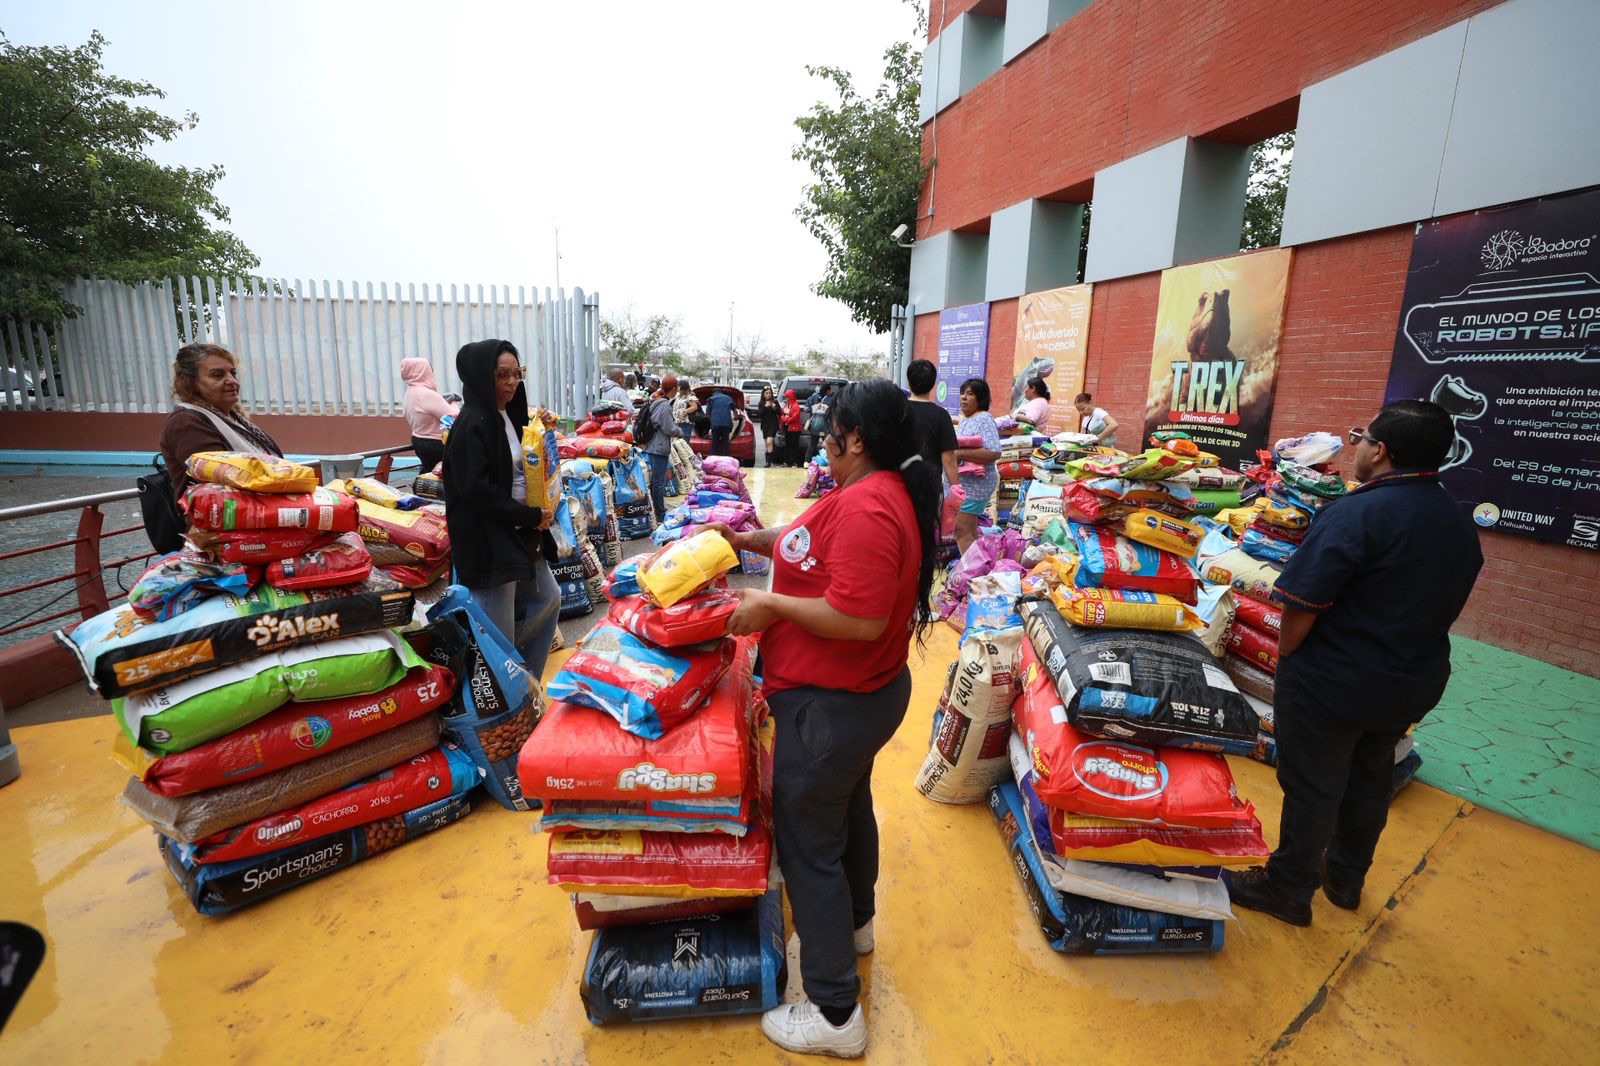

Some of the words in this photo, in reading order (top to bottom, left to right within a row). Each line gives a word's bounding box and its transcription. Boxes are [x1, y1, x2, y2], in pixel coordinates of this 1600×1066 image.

[1522, 238, 1590, 255] rodadora
[1529, 235, 1541, 247] la
[1521, 254, 1548, 263] espacio
[1549, 250, 1588, 260] interactivo
[1439, 317, 1457, 327] EL
[1462, 312, 1528, 326] MUNDO
[1534, 310, 1562, 322] DE
[1436, 325, 1563, 342] ROBOTS
[1528, 387, 1584, 396] exhibición
[1496, 398, 1515, 406] que
[1517, 398, 1556, 408] explora
[1180, 412, 1208, 423] Últimos
[1208, 415, 1224, 424] días
[1507, 418, 1578, 430] inteligencia
[1224, 428, 1248, 438] TIRANOS
[1528, 430, 1570, 440] nuestra
[1493, 458, 1515, 468] Del
[1518, 460, 1539, 470] 29
[1542, 464, 1561, 473] de
[1512, 474, 1524, 482] al
[1526, 474, 1548, 484] 29
[1552, 478, 1572, 487] de
[1502, 509, 1532, 522] UNITED
[1534, 514, 1555, 526] WAY
[1500, 520, 1534, 531] Chihuahua
[1566, 538, 1598, 550] FECHAC
[277, 613, 340, 642] Alex
[1263, 614, 1280, 628] Opti
[312, 630, 340, 640] CAN
[123, 665, 150, 682] 25
[416, 682, 440, 702] 25
[471, 678, 486, 710] Choice
[956, 676, 972, 706] 24,0
[348, 704, 380, 720] Bobby
[362, 713, 382, 724] Maxi
[619, 762, 716, 793] Shaggy
[1084, 757, 1156, 789] Shaggy
[257, 818, 301, 840] Optimo
[312, 804, 359, 825] CACHORRO
[370, 797, 380, 808] 20
[380, 796, 390, 806] kg
[242, 842, 344, 892] Sportsman's
[299, 858, 338, 878] Choice
